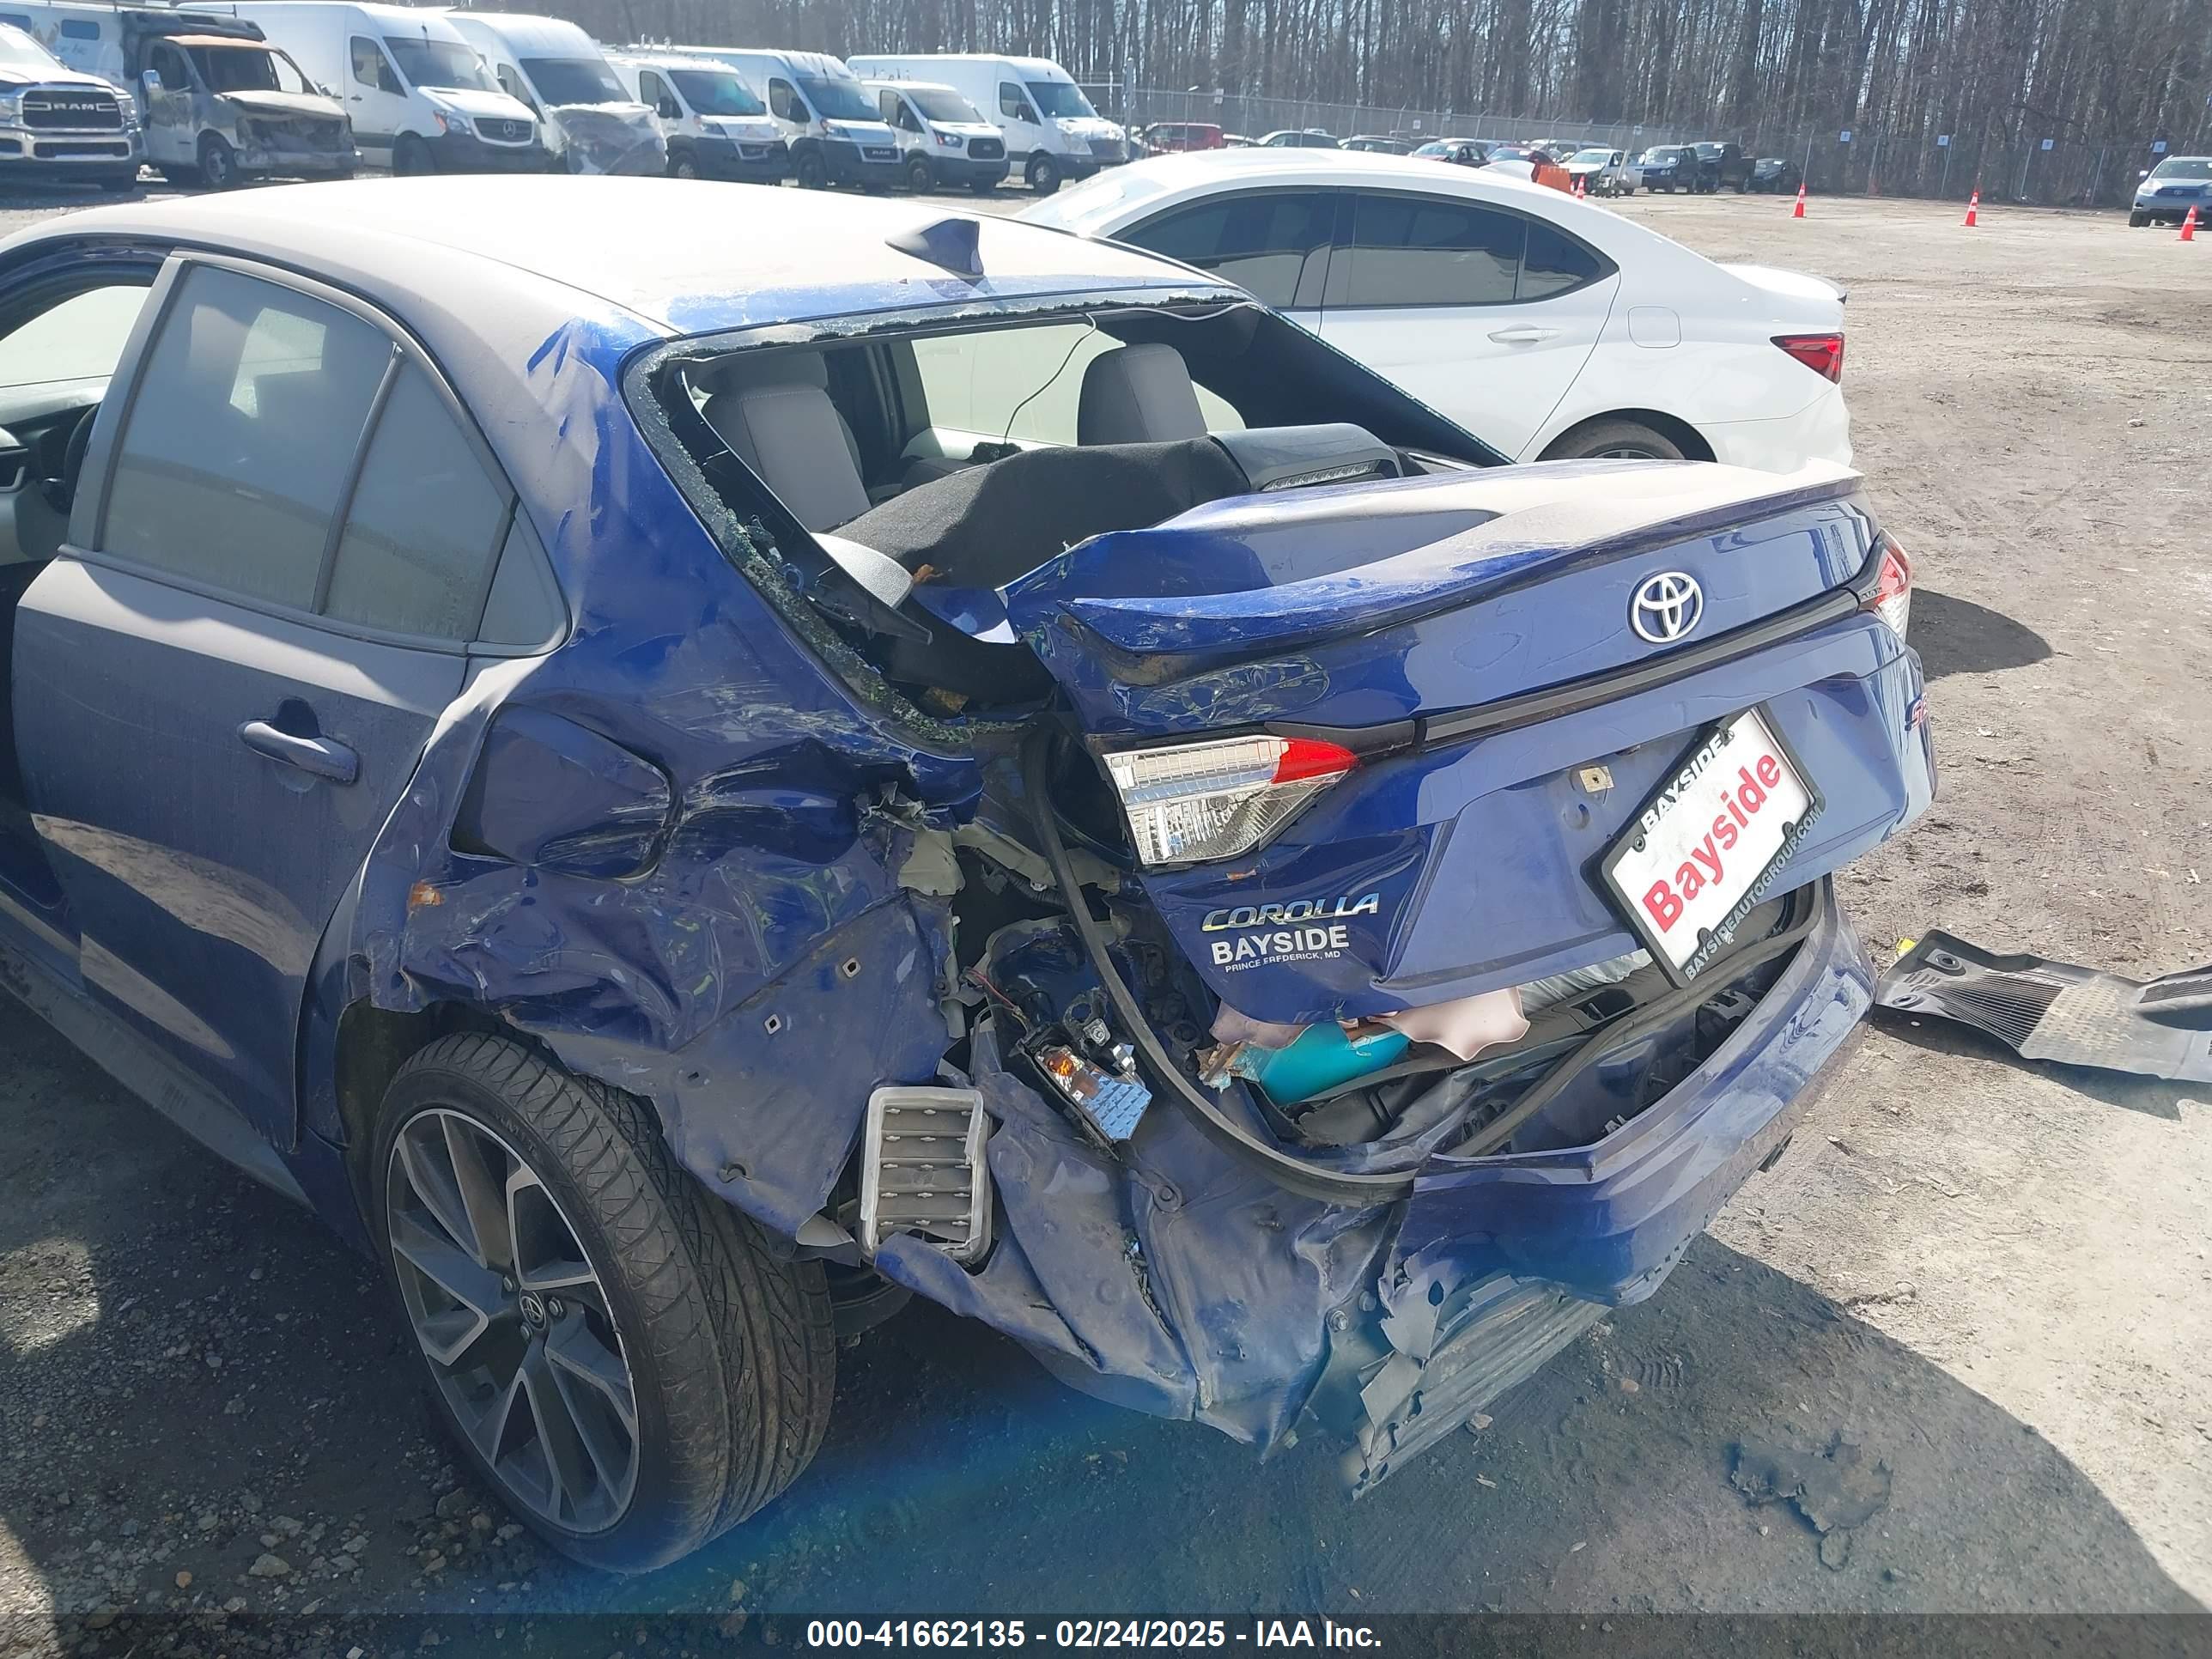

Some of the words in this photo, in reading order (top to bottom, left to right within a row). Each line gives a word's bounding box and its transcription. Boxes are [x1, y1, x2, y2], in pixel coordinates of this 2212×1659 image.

[53, 102, 94, 111] RAM
[1643, 734, 1726, 835] BAYSIDE
[1642, 754, 1781, 933] Bayside
[1201, 892, 1379, 932] COROLLA
[1684, 805, 1824, 981] BAYSIDEAUTOGROUP.COM
[1211, 925, 1349, 963] BAYSIDE
[1224, 959, 1261, 973] PRINCE
[1263, 951, 1323, 965] FREDERICK,
[1324, 951, 1340, 959] MD
